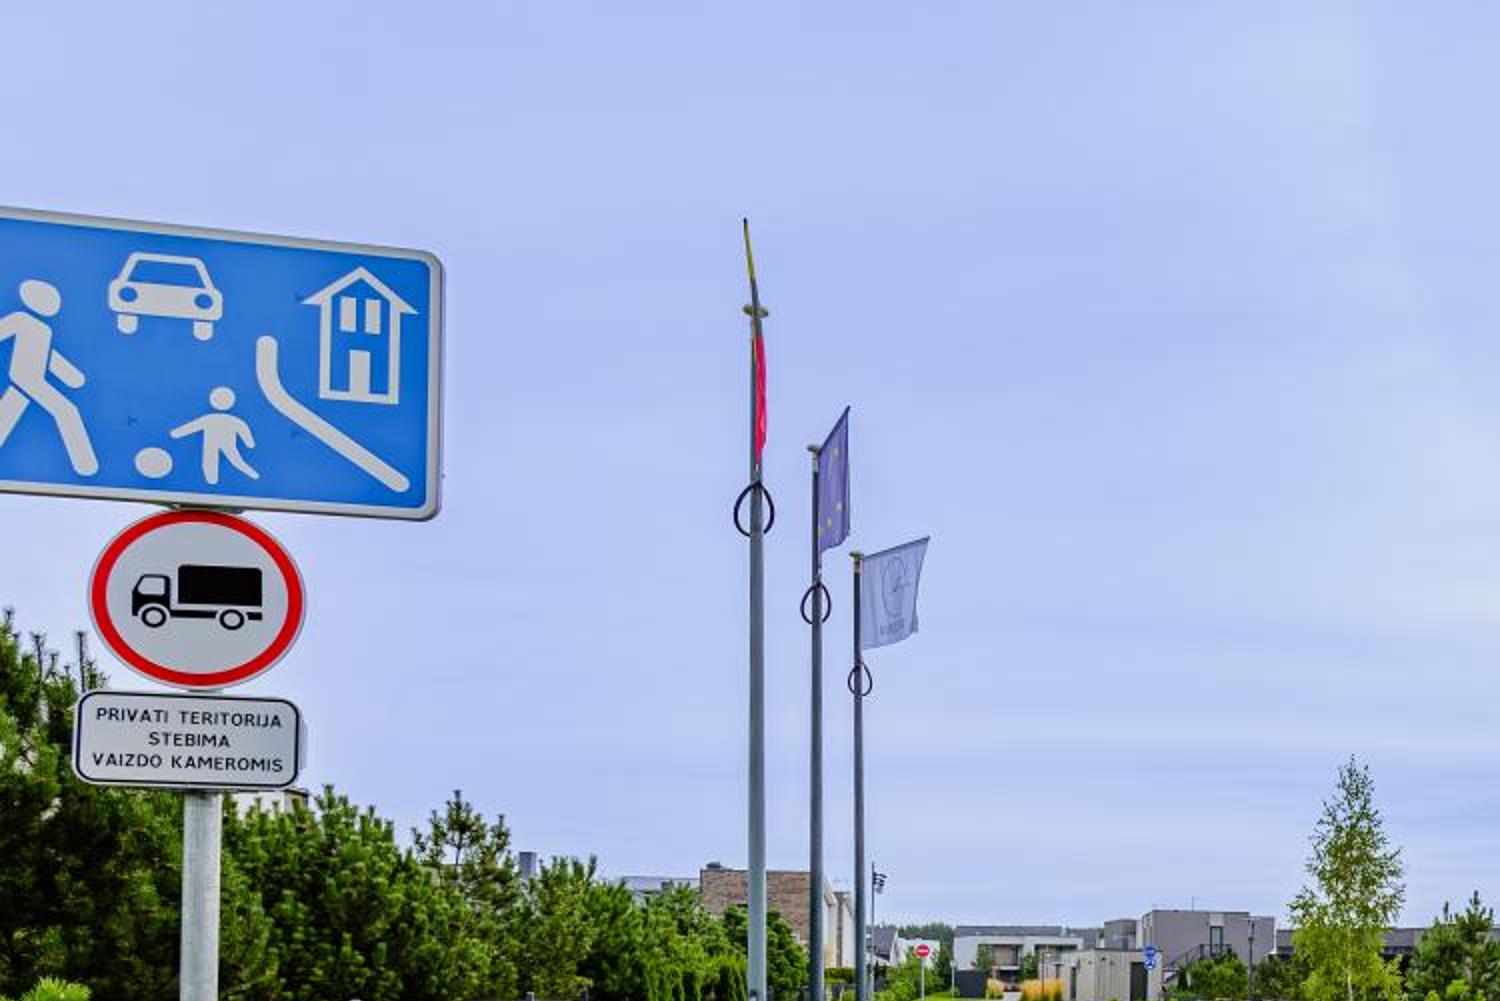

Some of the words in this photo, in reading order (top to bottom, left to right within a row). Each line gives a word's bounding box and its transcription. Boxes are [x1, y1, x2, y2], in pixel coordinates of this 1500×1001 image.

[96, 707, 169, 723] PRIVATI
[179, 711, 282, 728] TERITORIJA
[148, 731, 230, 748] STEBIMA
[92, 753, 163, 768] VAIZDO
[171, 755, 284, 773] KAMEROMIS
